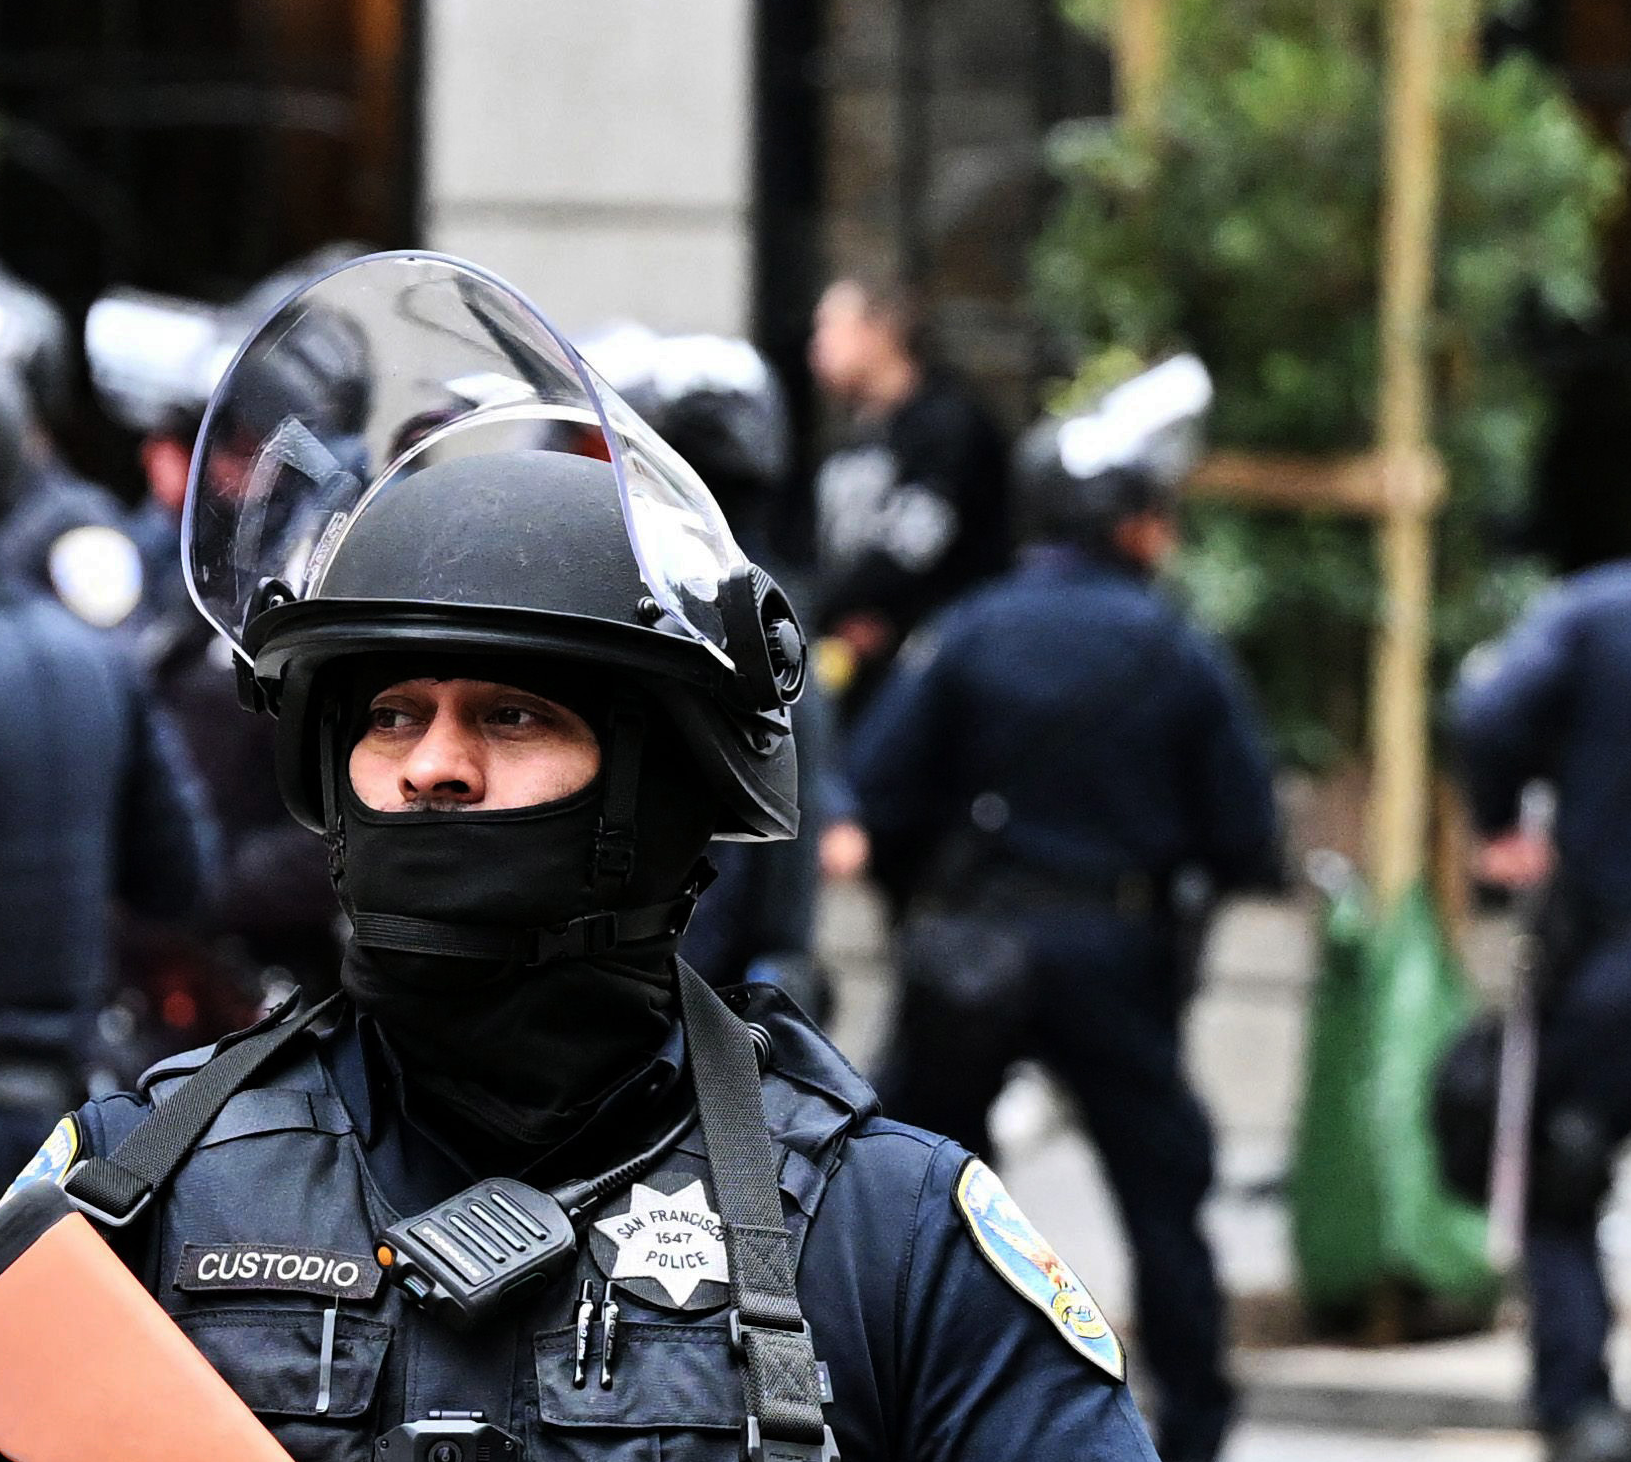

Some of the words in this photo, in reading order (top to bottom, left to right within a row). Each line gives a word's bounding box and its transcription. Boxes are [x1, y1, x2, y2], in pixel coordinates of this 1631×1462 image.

[617, 1217, 646, 1239] SAN
[649, 1209, 727, 1242] FRANCISCO
[197, 1251, 359, 1287] CUSTODIO
[645, 1250, 709, 1269] POLICE
